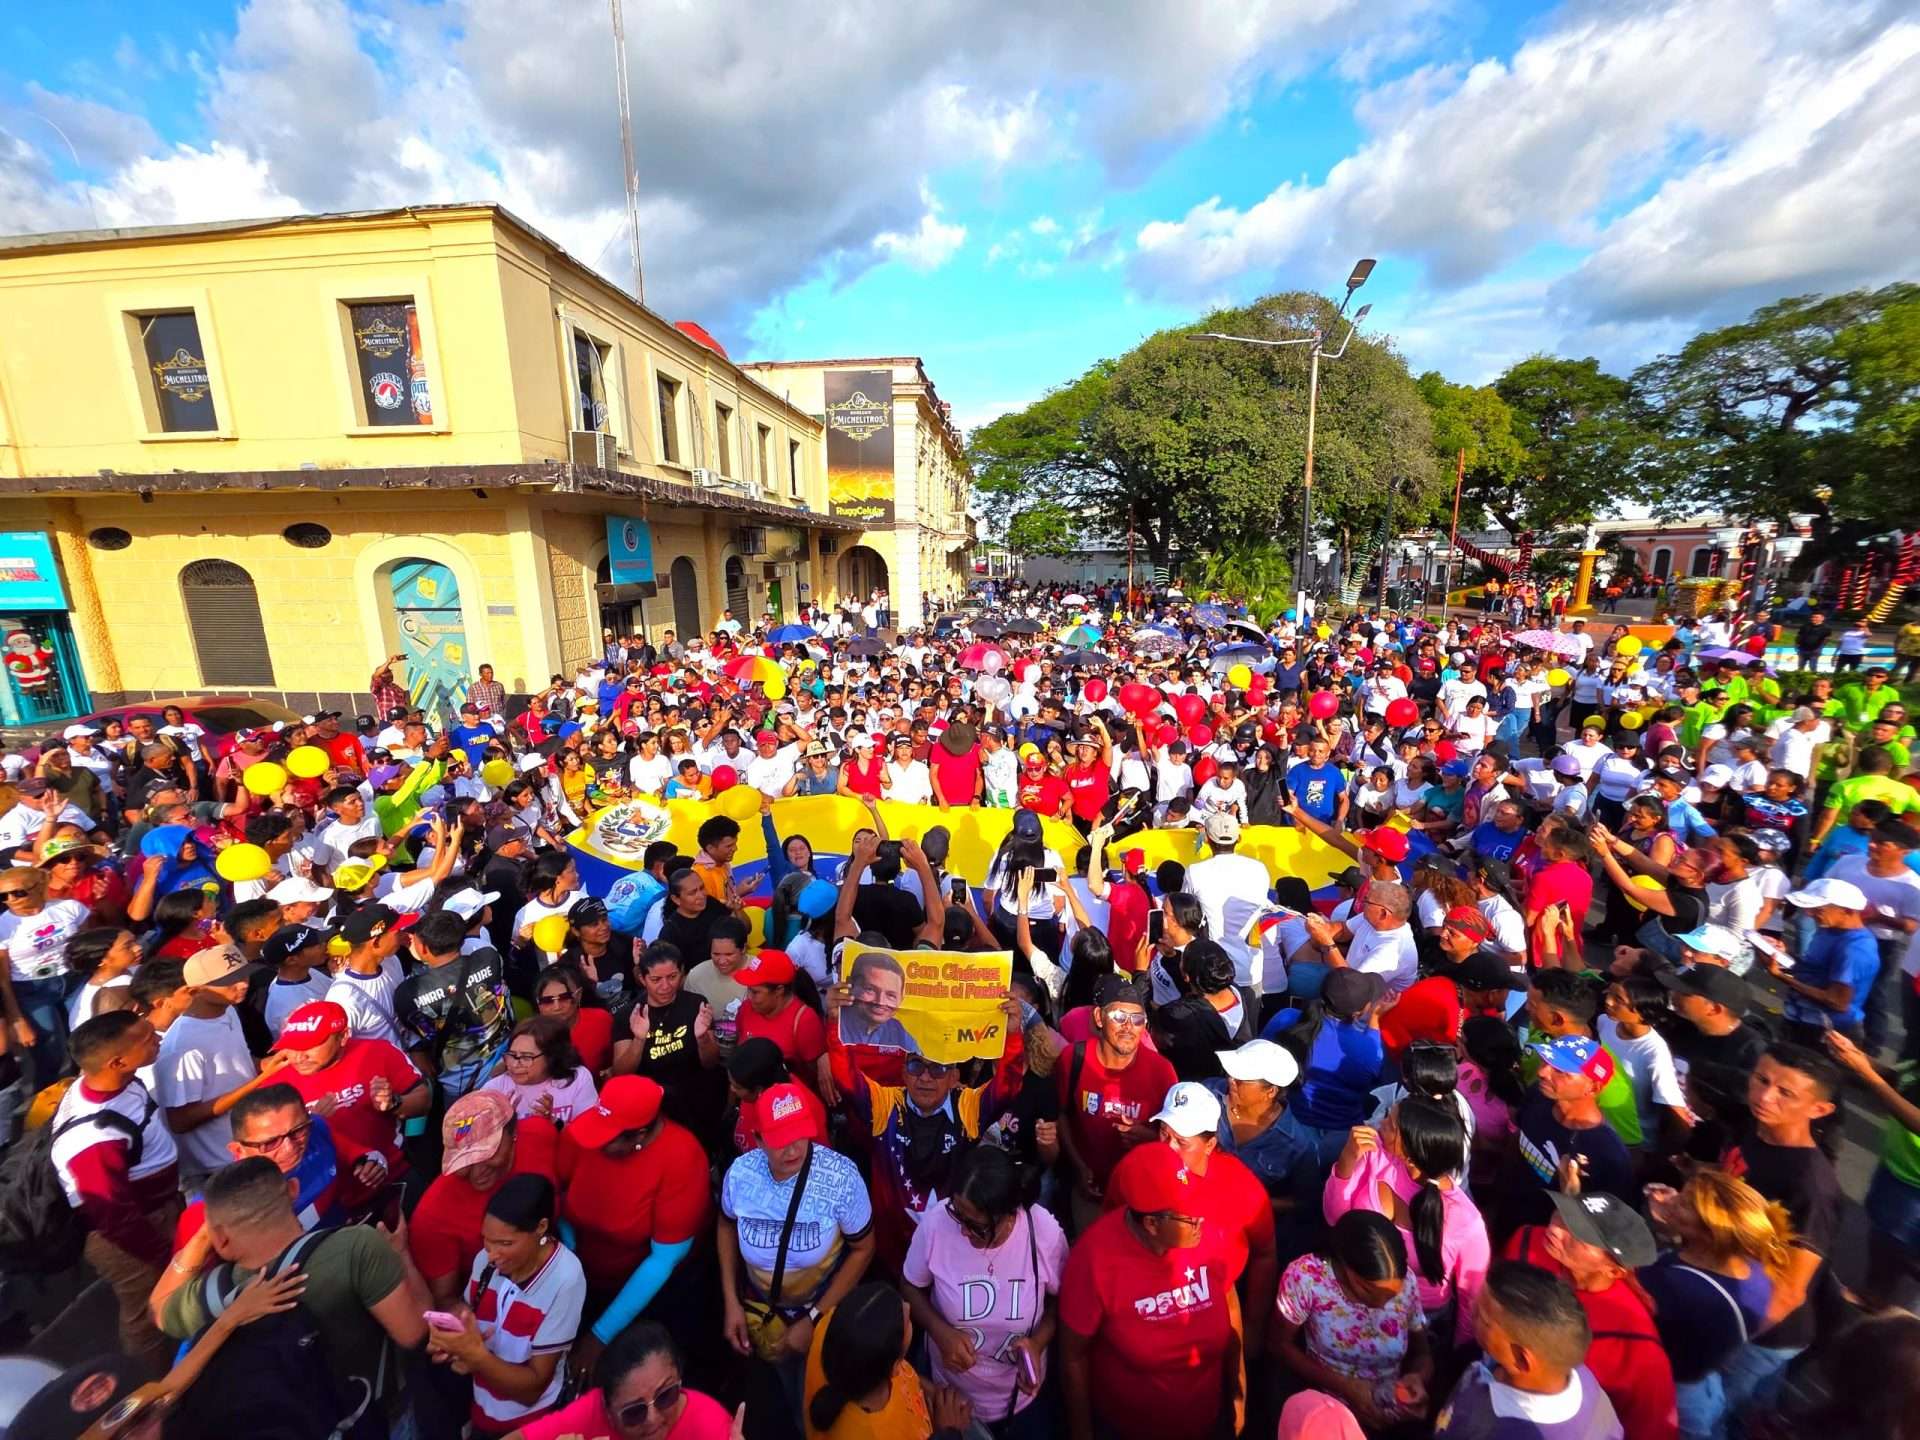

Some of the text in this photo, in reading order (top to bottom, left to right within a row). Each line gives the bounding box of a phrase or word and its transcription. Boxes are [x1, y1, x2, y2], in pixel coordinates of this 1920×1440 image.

[906, 961, 940, 979] Con
[958, 1021, 999, 1043] MVR
[740, 1216, 822, 1253] VENEELA
